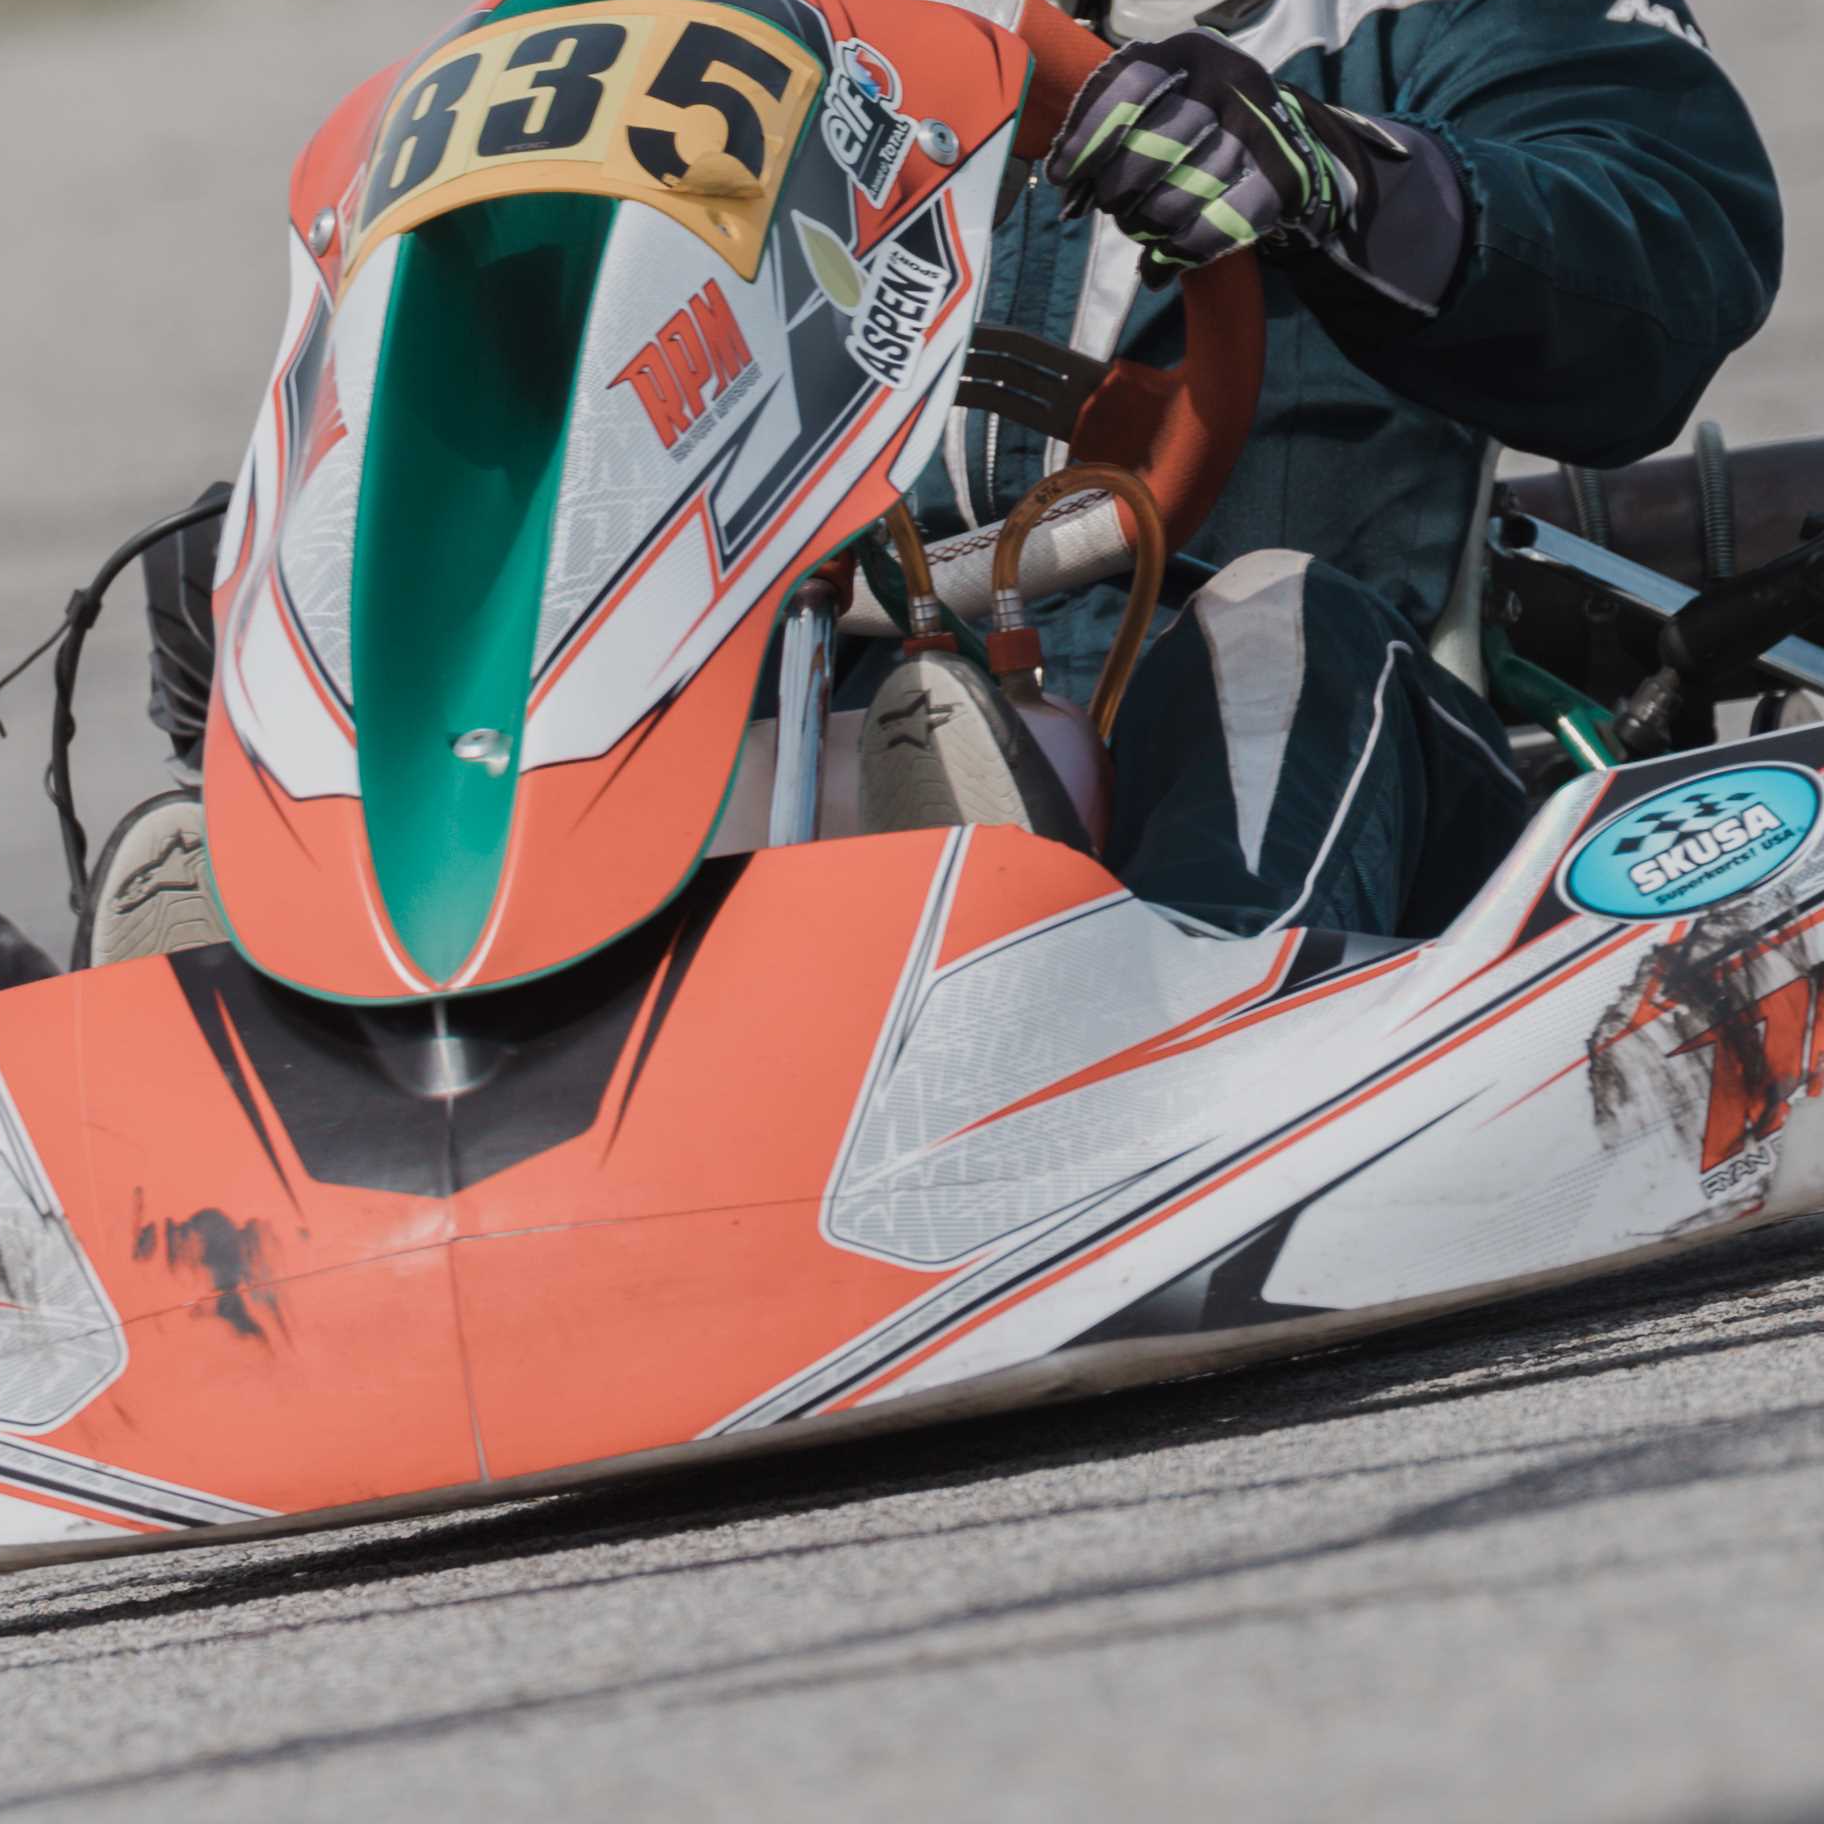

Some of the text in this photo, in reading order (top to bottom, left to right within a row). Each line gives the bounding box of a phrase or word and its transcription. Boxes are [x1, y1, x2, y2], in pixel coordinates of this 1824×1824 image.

[359, 21, 793, 233] 835
[828, 76, 875, 166] elf
[879, 121, 912, 162] TOTAL
[605, 277, 754, 450] RPM
[856, 263, 934, 385] ASPEN
[1628, 801, 1786, 897] SKUSA
